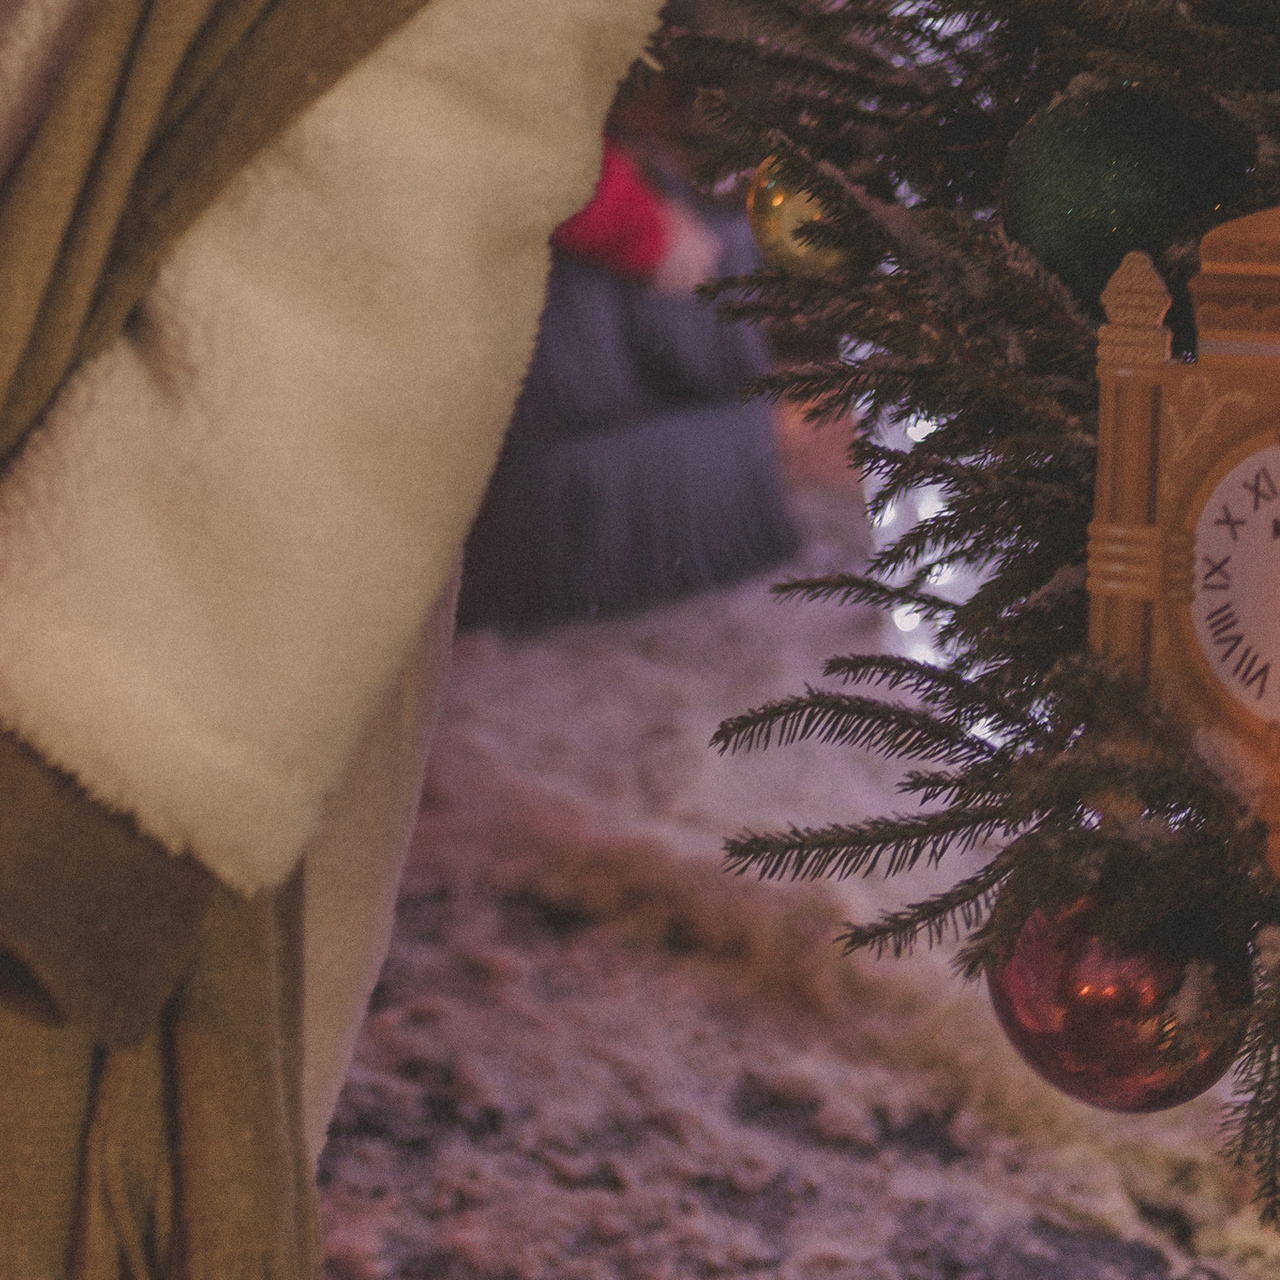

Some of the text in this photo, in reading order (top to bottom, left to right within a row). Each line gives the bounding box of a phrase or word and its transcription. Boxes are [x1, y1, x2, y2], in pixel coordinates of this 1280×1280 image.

[1214, 504, 1246, 541] X
[1202, 555, 1231, 590] IX
[1206, 602, 1243, 662] VIII
[1232, 646, 1270, 700] VII
